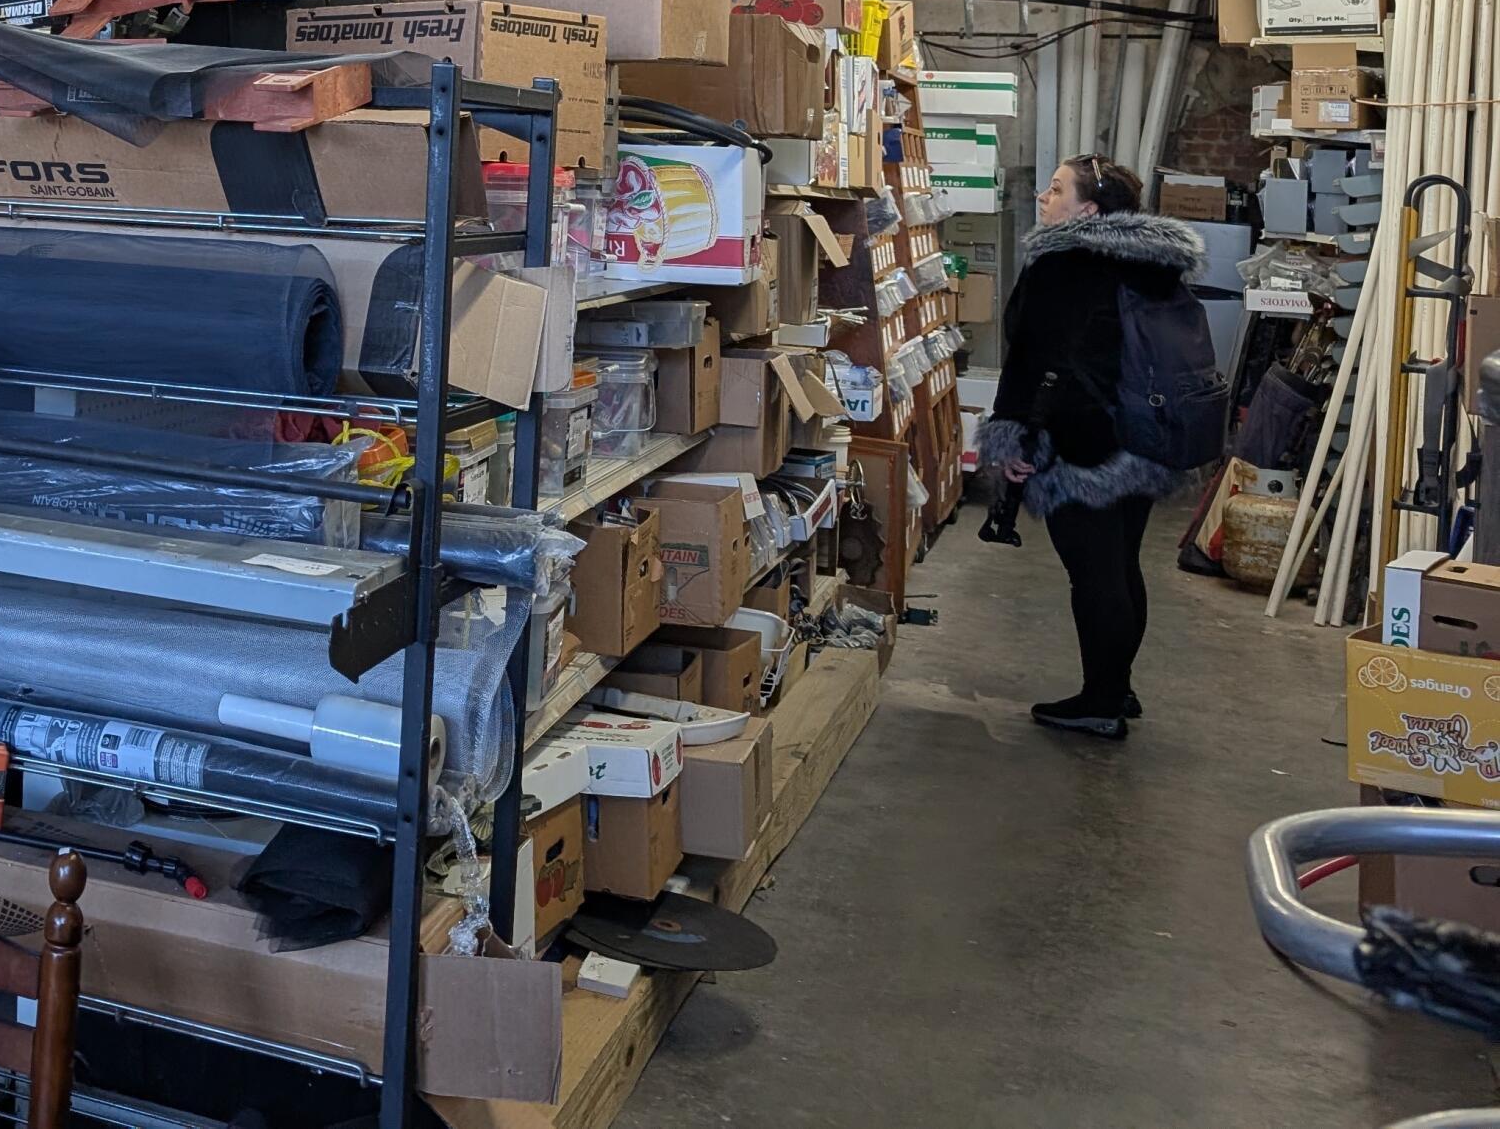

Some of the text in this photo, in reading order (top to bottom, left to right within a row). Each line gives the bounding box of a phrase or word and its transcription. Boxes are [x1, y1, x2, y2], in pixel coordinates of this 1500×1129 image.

[294, 18, 466, 45] Fresh Tomatoes
[490, 17, 599, 48] Fresh Tomatoes
[30, 183, 116, 199] SAINT-GOBAIN
[1259, 297, 1313, 309] OMATOES
[660, 548, 700, 564] NTAIN
[1409, 677, 1471, 700] Oranges
[1401, 712, 1468, 748] Citrus
[1370, 728, 1431, 766] Sweet
